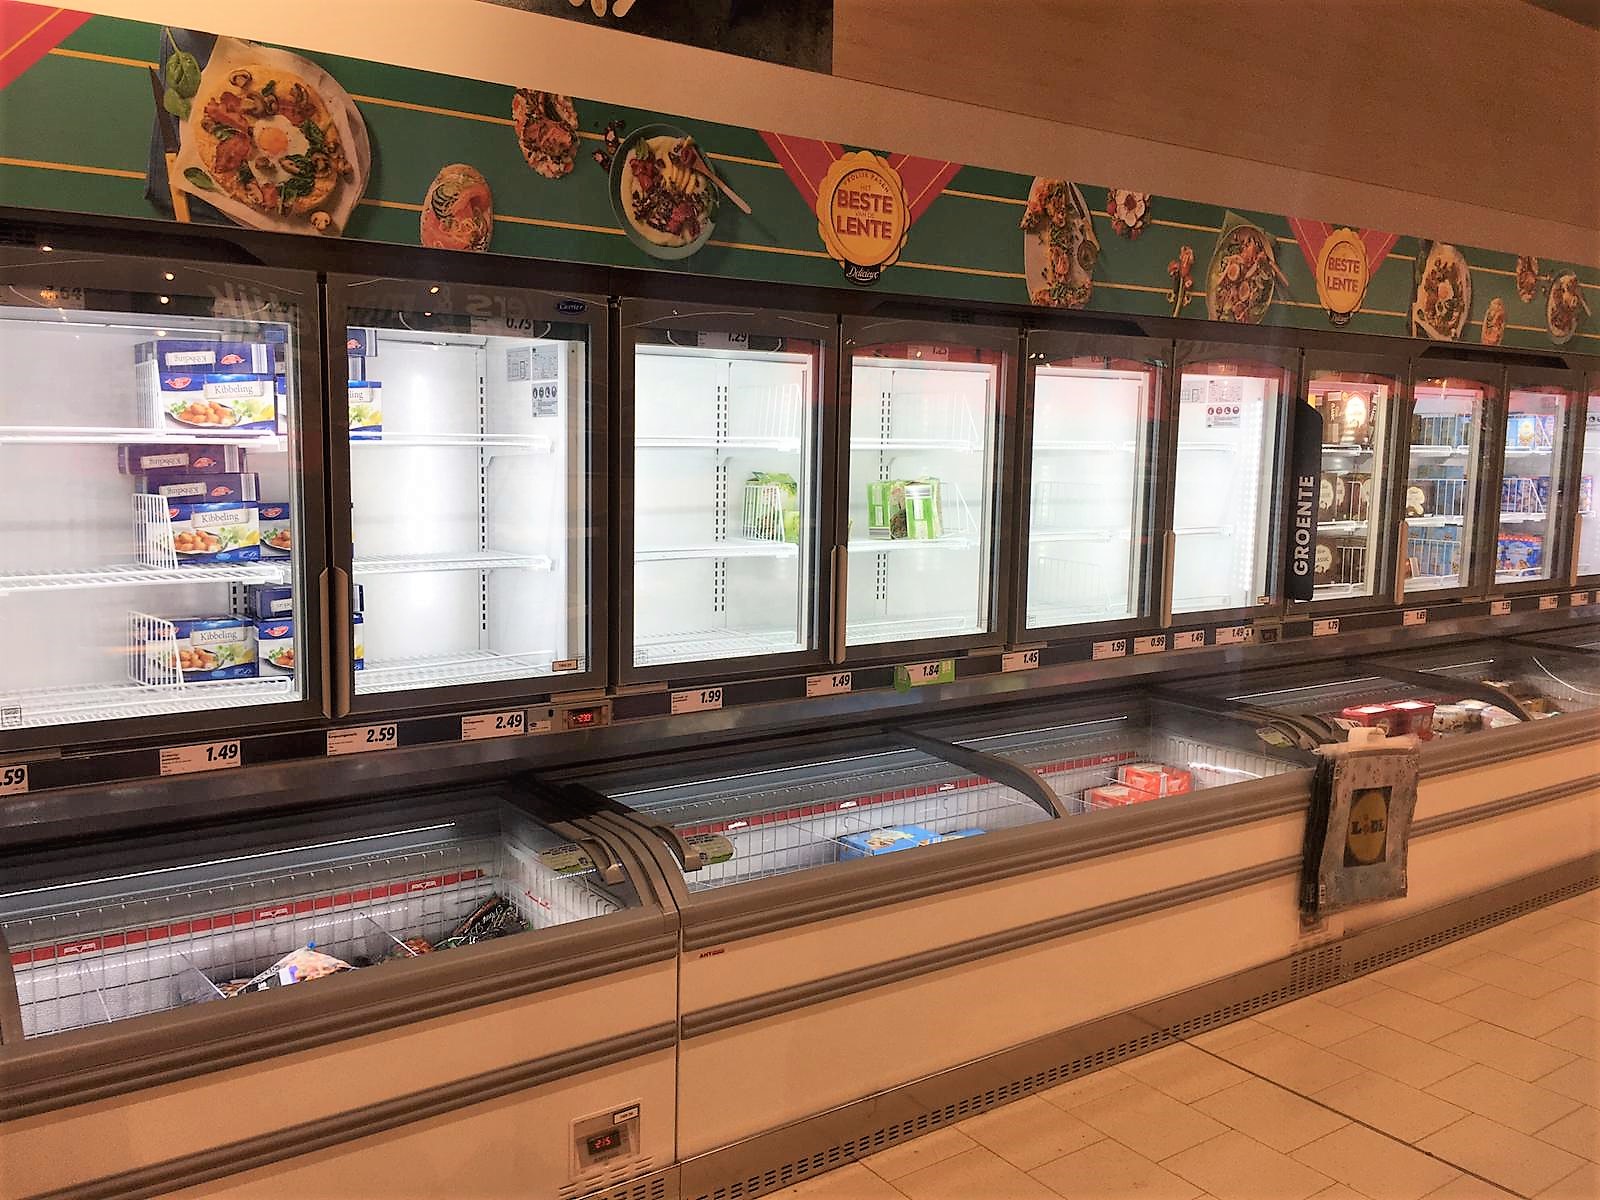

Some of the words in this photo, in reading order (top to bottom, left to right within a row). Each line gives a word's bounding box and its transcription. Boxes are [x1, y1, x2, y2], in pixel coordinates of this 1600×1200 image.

[837, 189, 893, 214] BESTE
[836, 216, 892, 239] LENTE
[1328, 257, 1360, 273] BESTE
[1327, 276, 1358, 292] LENTE
[728, 331, 747, 342] 1.29
[215, 384, 254, 395] Kibbeling
[349, 390, 364, 400] ling
[201, 512, 240, 523] Kibbeling
[1293, 476, 1314, 576] GROENTE
[200, 631, 238, 641] Kibbeling
[1191, 632, 1203, 643] 1.49
[1111, 641, 1125, 652] 1.99
[1023, 652, 1038, 664] 1.45
[923, 664, 940, 677] 1.84
[831, 674, 850, 687] 1.49
[700, 690, 721, 704] 1.99
[495, 714, 522, 729] 2.49
[366, 727, 395, 743] 2.59
[206, 744, 238, 761] 1.49
